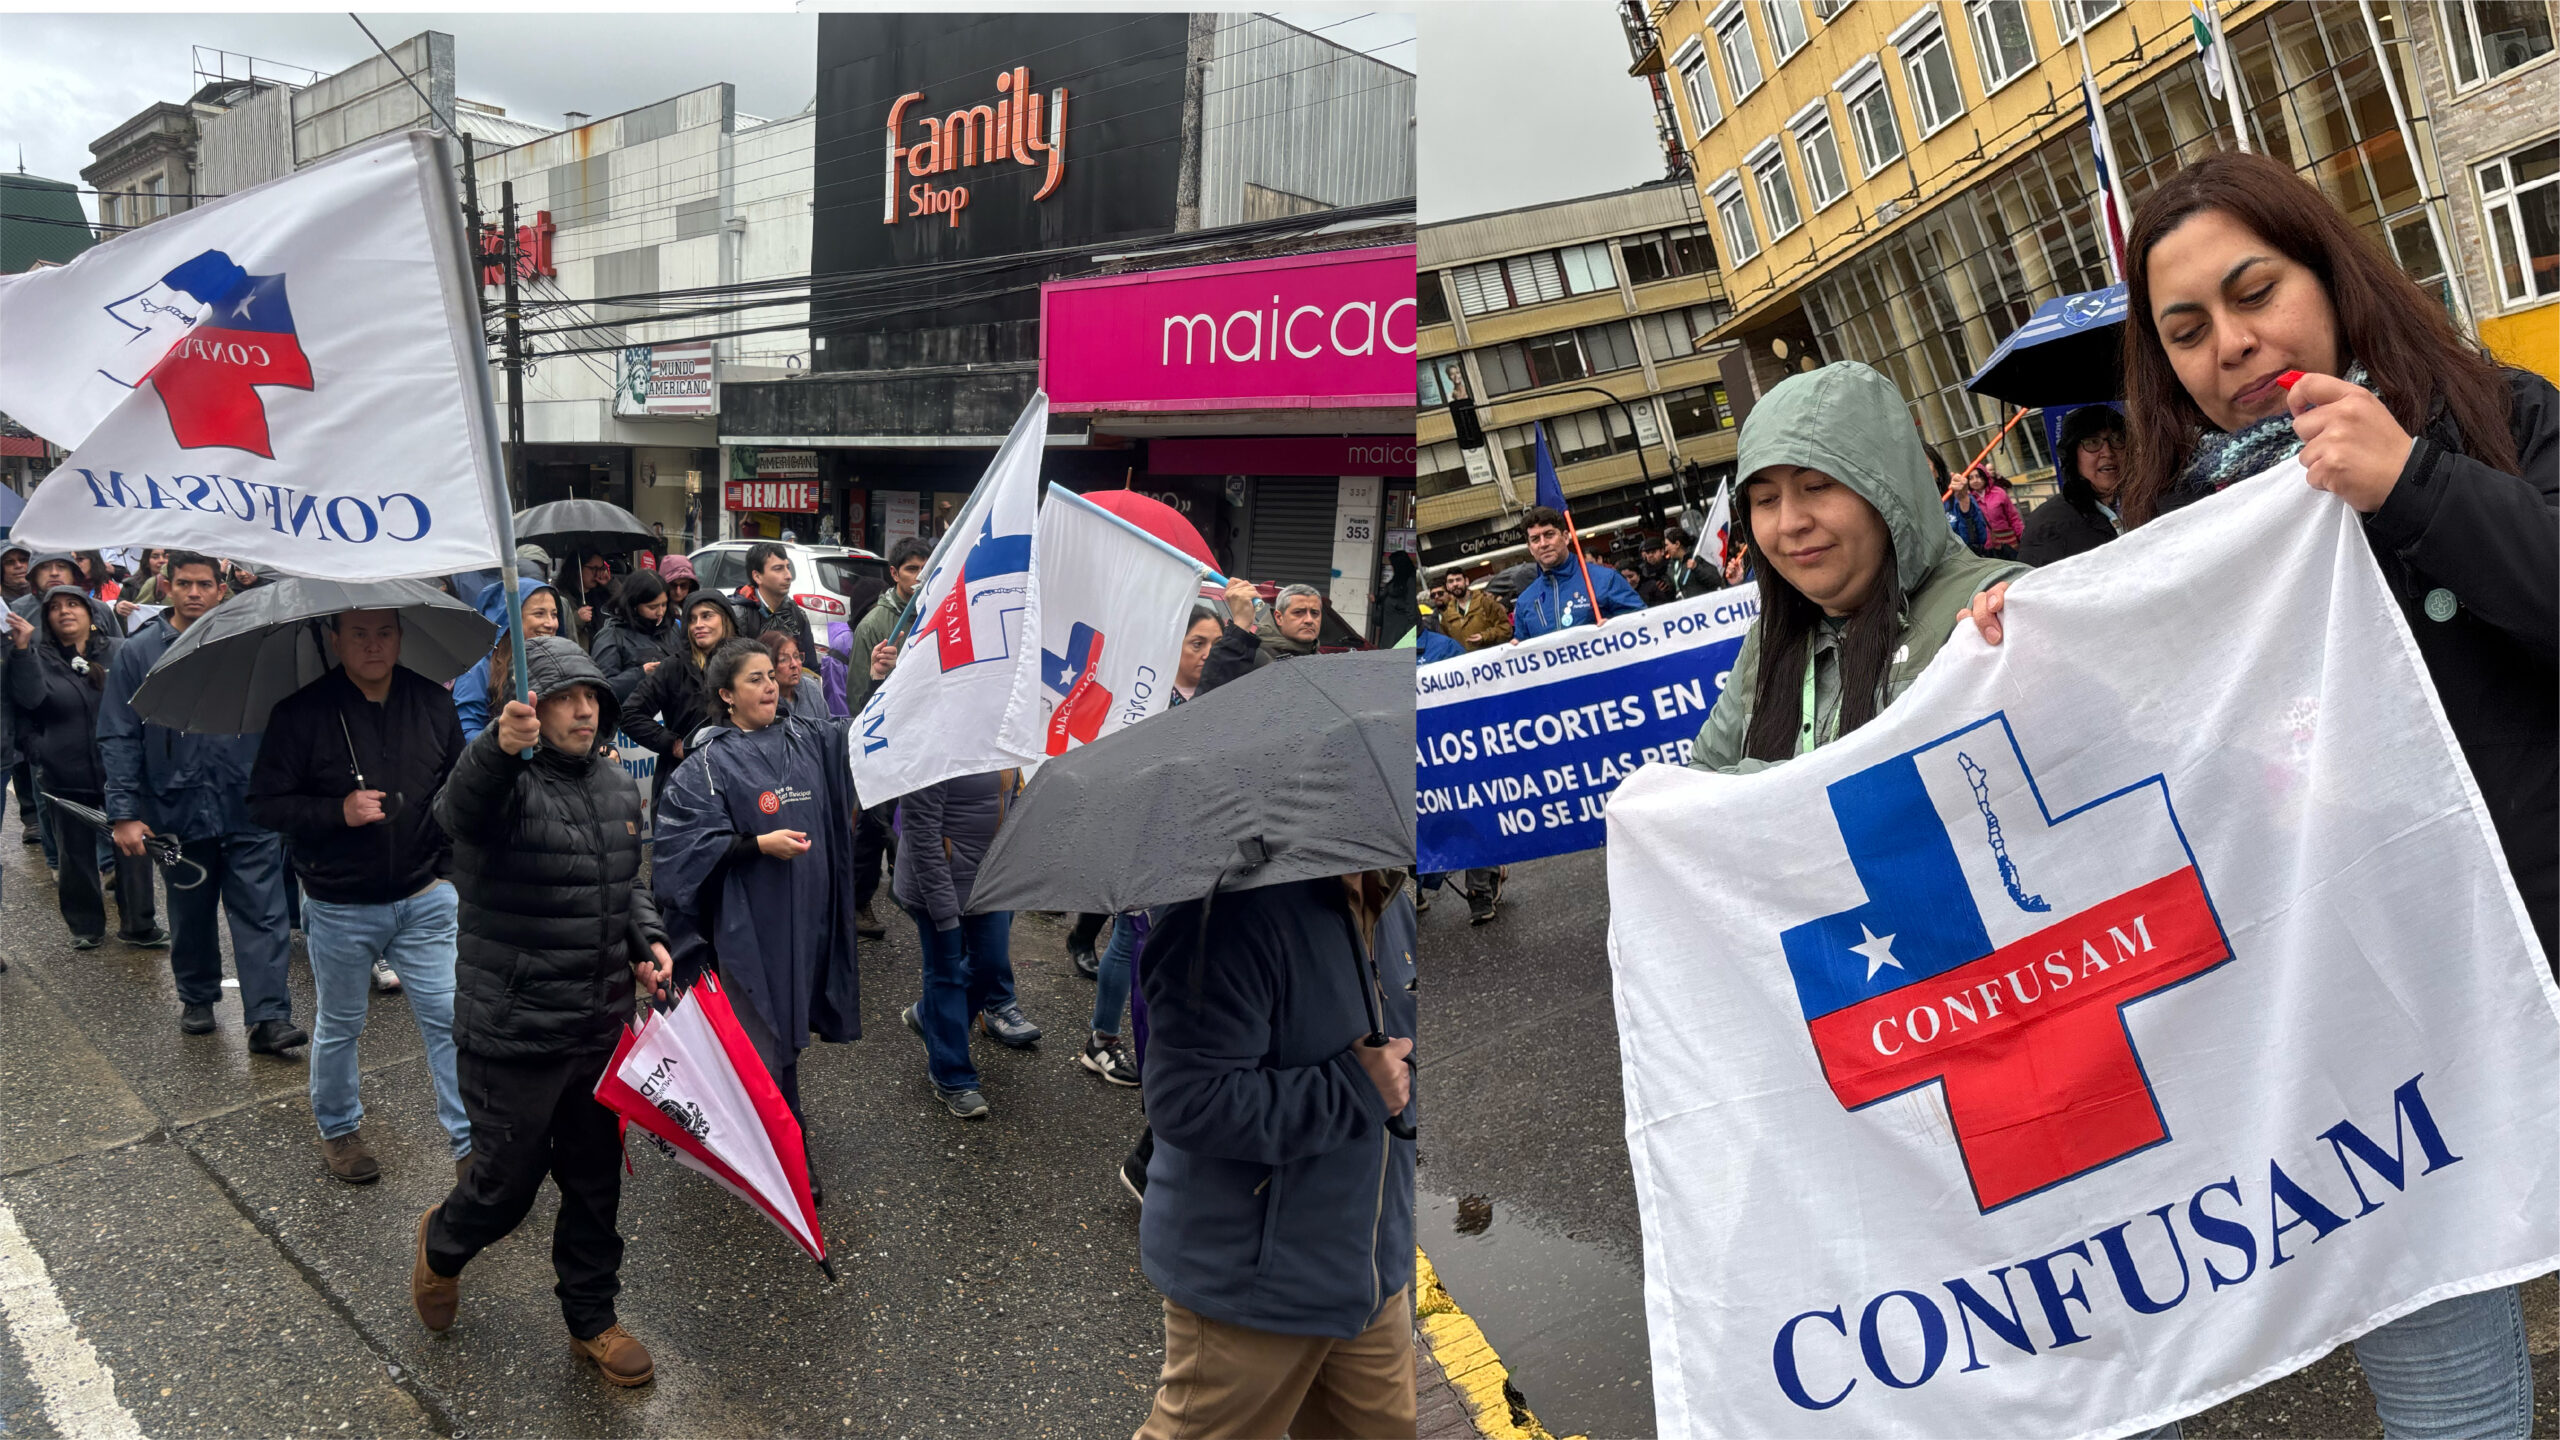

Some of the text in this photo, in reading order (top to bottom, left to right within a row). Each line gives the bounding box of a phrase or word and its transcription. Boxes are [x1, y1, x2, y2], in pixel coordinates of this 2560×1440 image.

[909, 183, 970, 228] Shop
[648, 380, 708, 395] AMERICANO
[659, 360, 695, 376] MUNDO
[742, 483, 808, 509] REMATE
[1346, 526, 1370, 539] 353
[1421, 670, 1471, 694] SALUD,
[1471, 661, 1506, 684] POR
[1505, 653, 1541, 676] TUS
[1543, 627, 1658, 668] DERECHOS,
[1663, 613, 1711, 639] POR
[1427, 729, 1478, 766] LOS
[1481, 695, 1646, 757] RECORTES
[1652, 678, 1707, 721] EN
[1454, 783, 1484, 810] LA
[1481, 773, 1543, 805] VIDA
[1543, 765, 1580, 795] DE
[1582, 752, 1637, 787] LAS
[1497, 807, 1537, 836] NO
[1541, 800, 1575, 829] SE
[1872, 914, 2157, 1056] CONFUSAM
[640, 1057, 678, 1097] VALD
[1772, 1072, 2464, 1411] CONFUSAM
